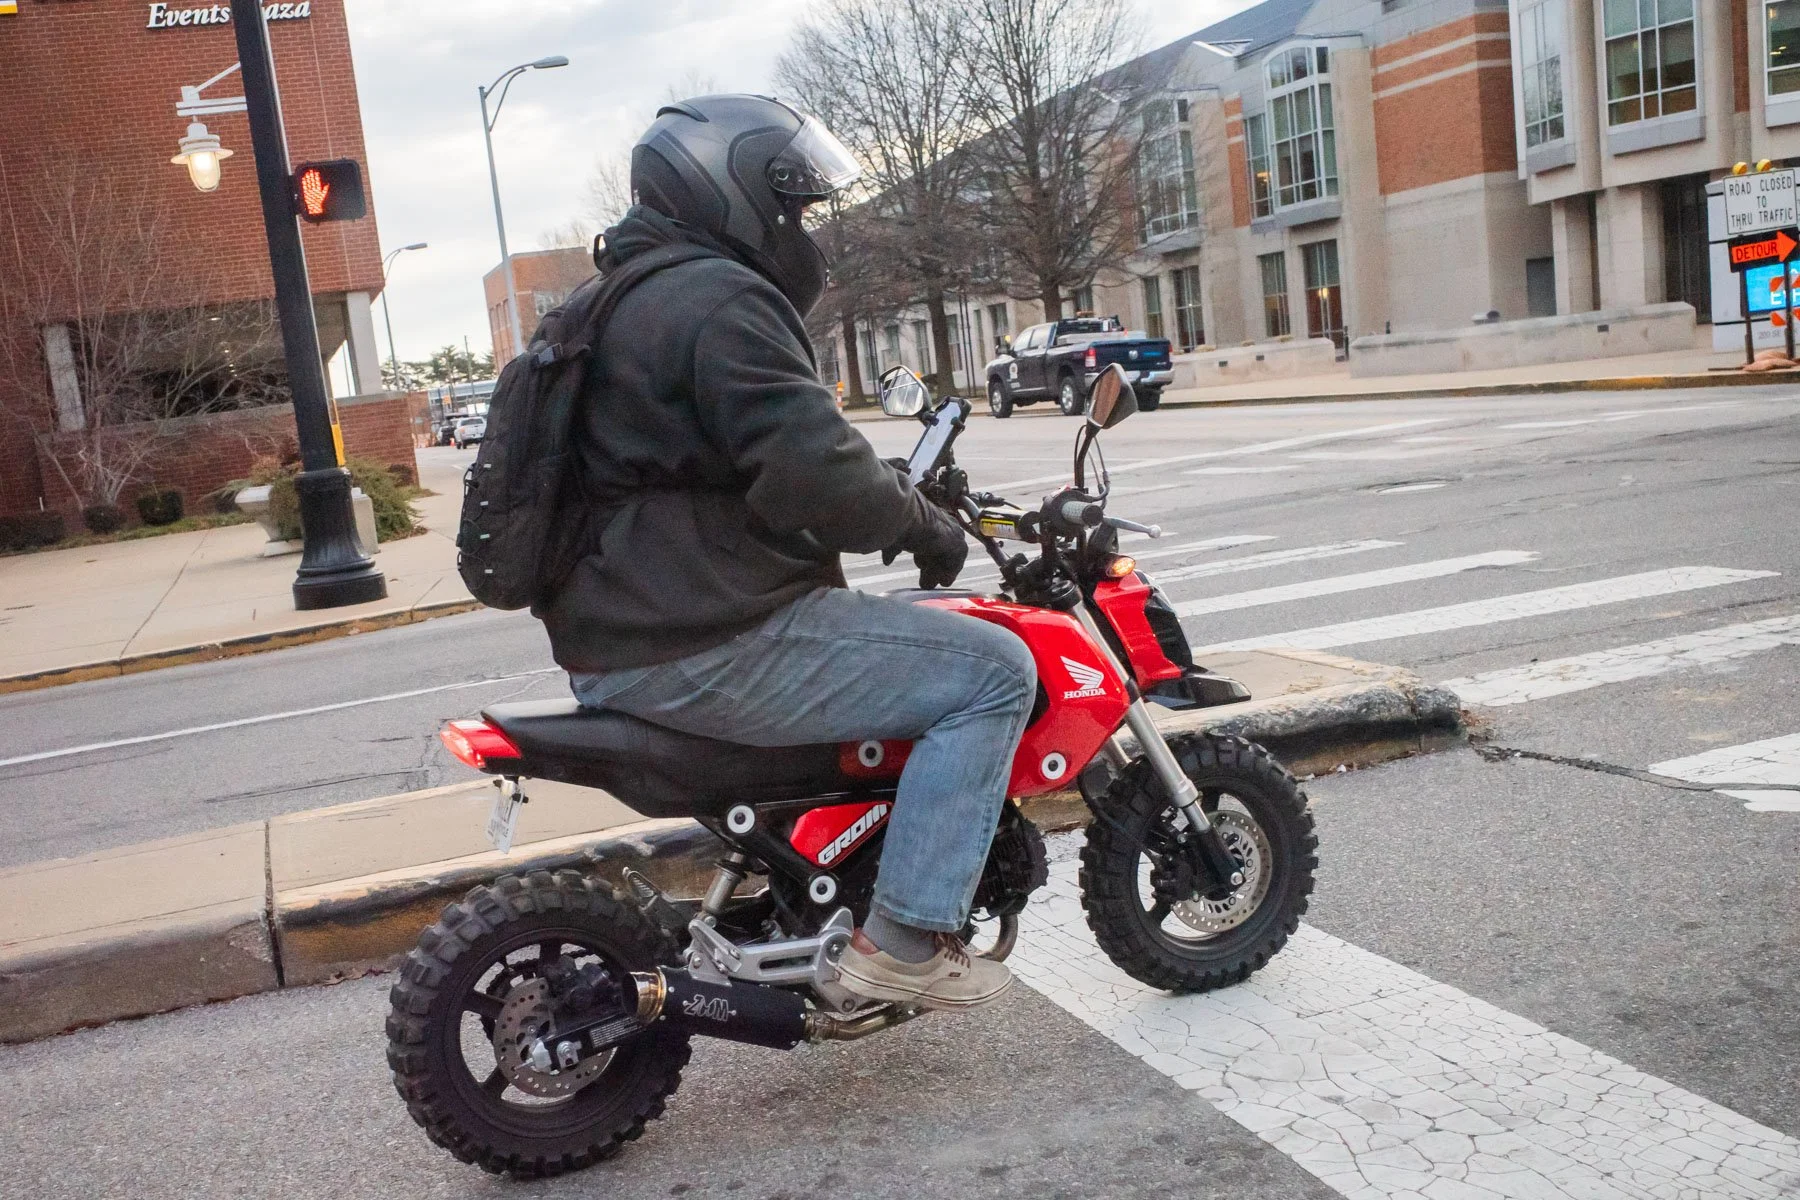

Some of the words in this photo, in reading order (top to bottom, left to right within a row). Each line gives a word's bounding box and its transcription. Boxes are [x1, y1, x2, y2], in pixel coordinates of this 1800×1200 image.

[146, 2, 231, 28] Events
[261, 1, 311, 20] aza
[1729, 181, 1752, 196] ROAD
[1760, 176, 1793, 192] CLOSED
[1757, 195, 1767, 208] TO
[1731, 212, 1753, 227] THRU
[1759, 207, 1793, 223] TRAFFIC
[1735, 241, 1778, 261] DETOUR
[1063, 687, 1107, 699] HONDA
[817, 803, 888, 865] GROM
